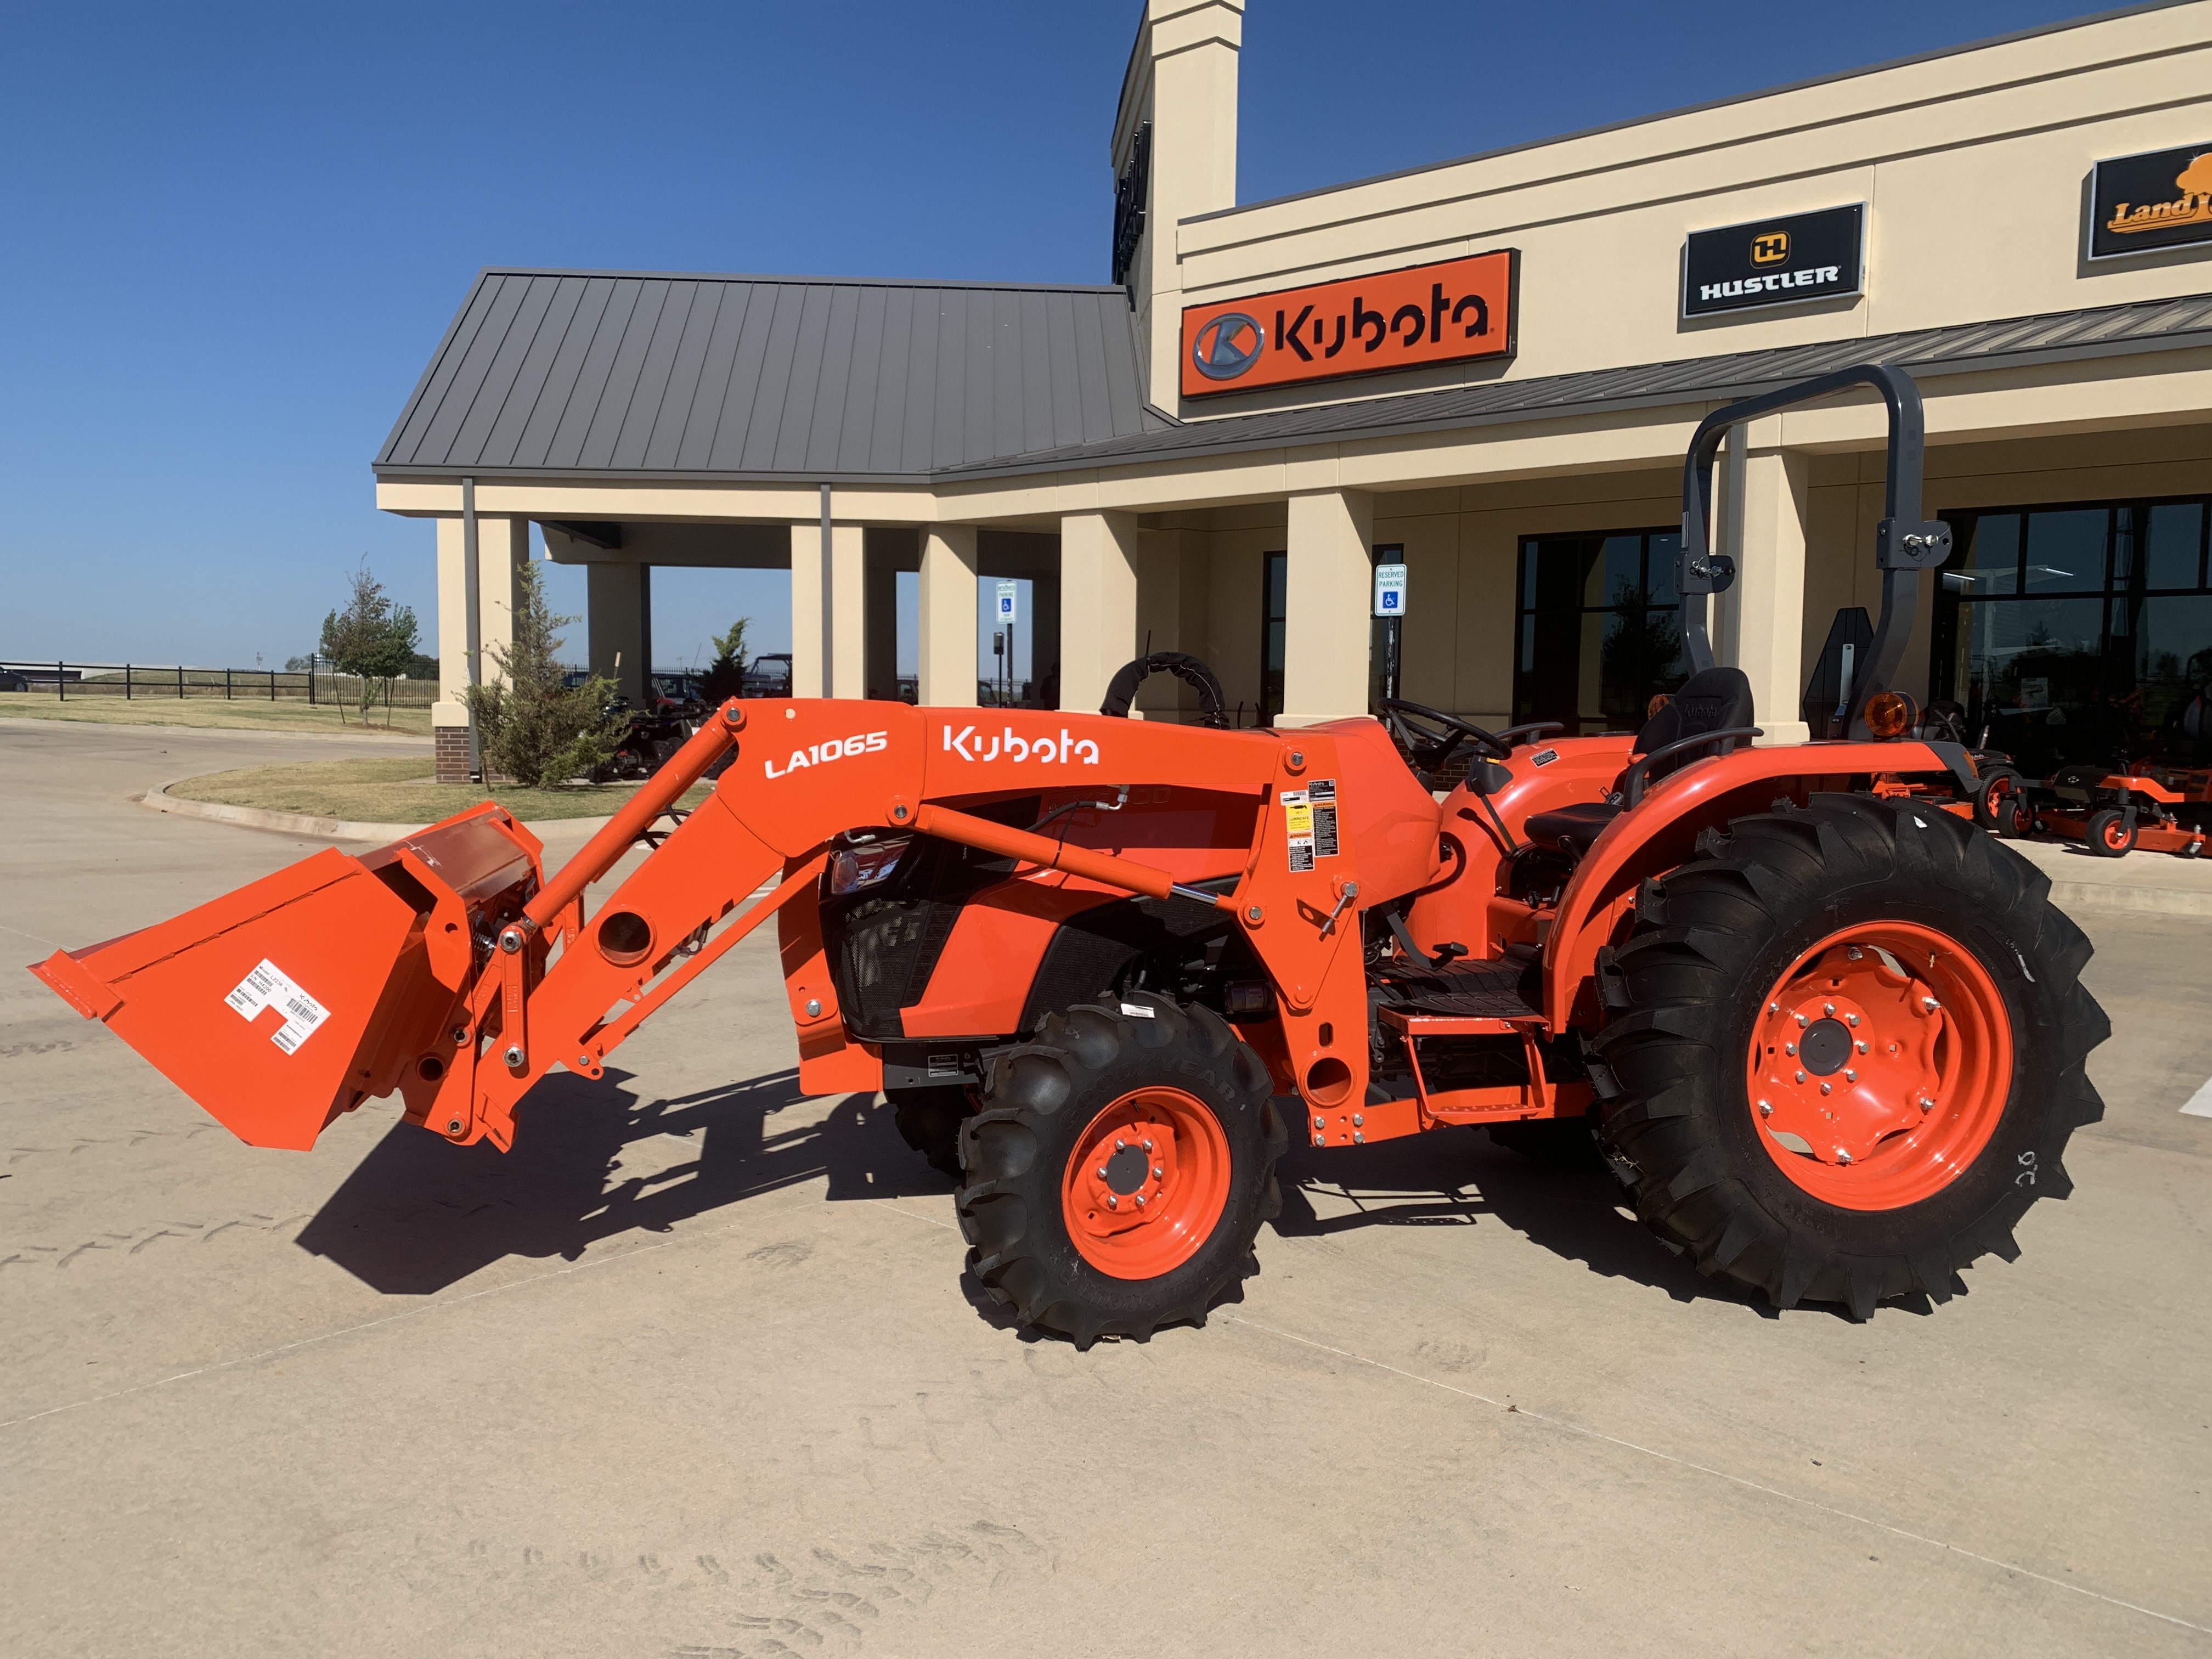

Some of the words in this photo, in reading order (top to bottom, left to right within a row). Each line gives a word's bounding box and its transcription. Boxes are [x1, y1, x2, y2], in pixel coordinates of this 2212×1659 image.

[1700, 266, 1839, 301] HUSTLER
[1275, 283, 1489, 362] Kubota
[764, 730, 888, 780] LA1065
[943, 725, 1099, 764] Kubota
[258, 981, 272, 993] H4200
[259, 966, 270, 975] Model
[300, 994, 318, 1011] Kubota
[1059, 1052, 1236, 1129] GOODYEAR
